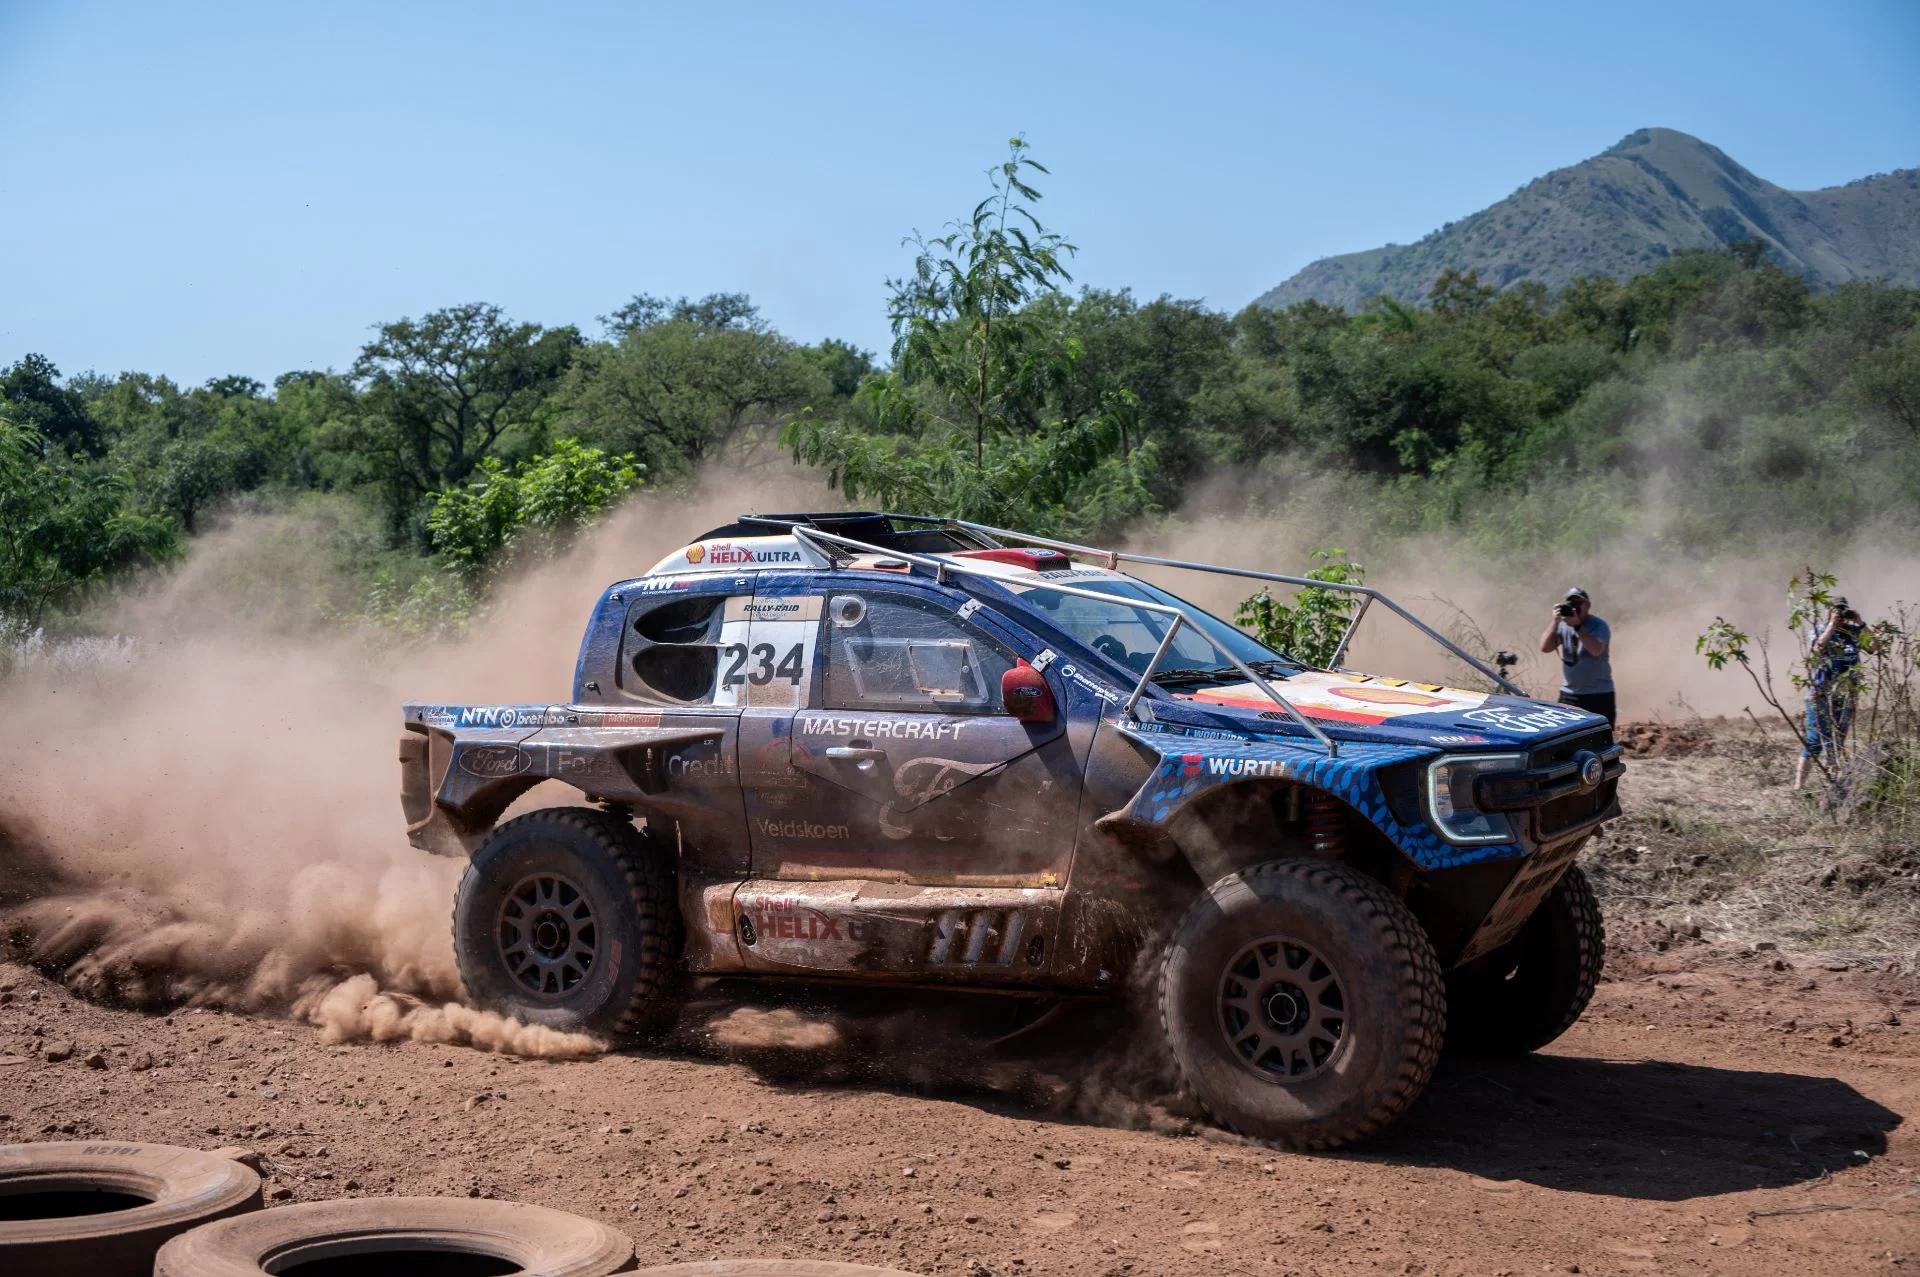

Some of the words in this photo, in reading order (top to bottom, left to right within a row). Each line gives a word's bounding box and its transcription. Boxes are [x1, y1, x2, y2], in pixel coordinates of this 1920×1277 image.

[711, 551, 756, 563] HELIX
[757, 551, 802, 563] ULTRA
[722, 642, 804, 686] 234
[461, 708, 500, 724] NTN
[517, 711, 565, 725] brembo
[1462, 705, 1587, 732] Ford
[802, 717, 966, 740] MASTERCRAFT
[471, 749, 518, 772] Ford
[668, 753, 733, 776] Credit
[757, 819, 850, 839] Veldskoen
[756, 897, 793, 911] Shell
[755, 914, 844, 940] HELIX
